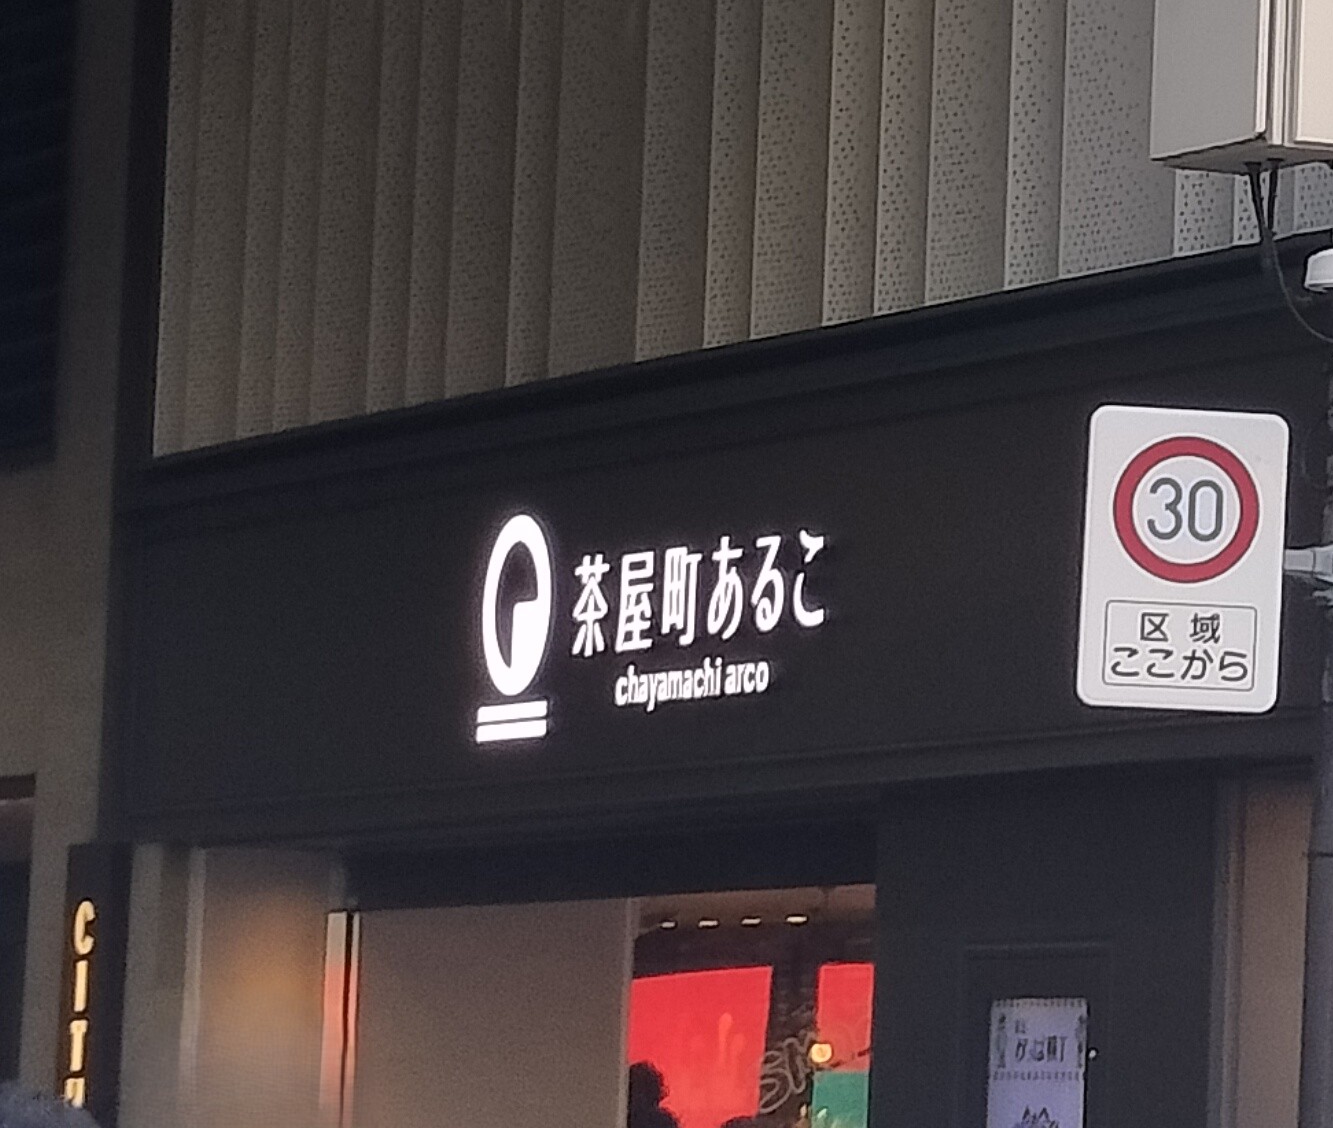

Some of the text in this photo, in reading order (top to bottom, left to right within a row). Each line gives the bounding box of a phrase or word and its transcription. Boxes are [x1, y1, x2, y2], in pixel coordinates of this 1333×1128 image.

[1146, 476, 1223, 542] 30
[571, 529, 825, 658] 茶屋町あるこ
[614, 657, 770, 713] chayamachi arco
[1110, 647, 1248, 682] ここから
